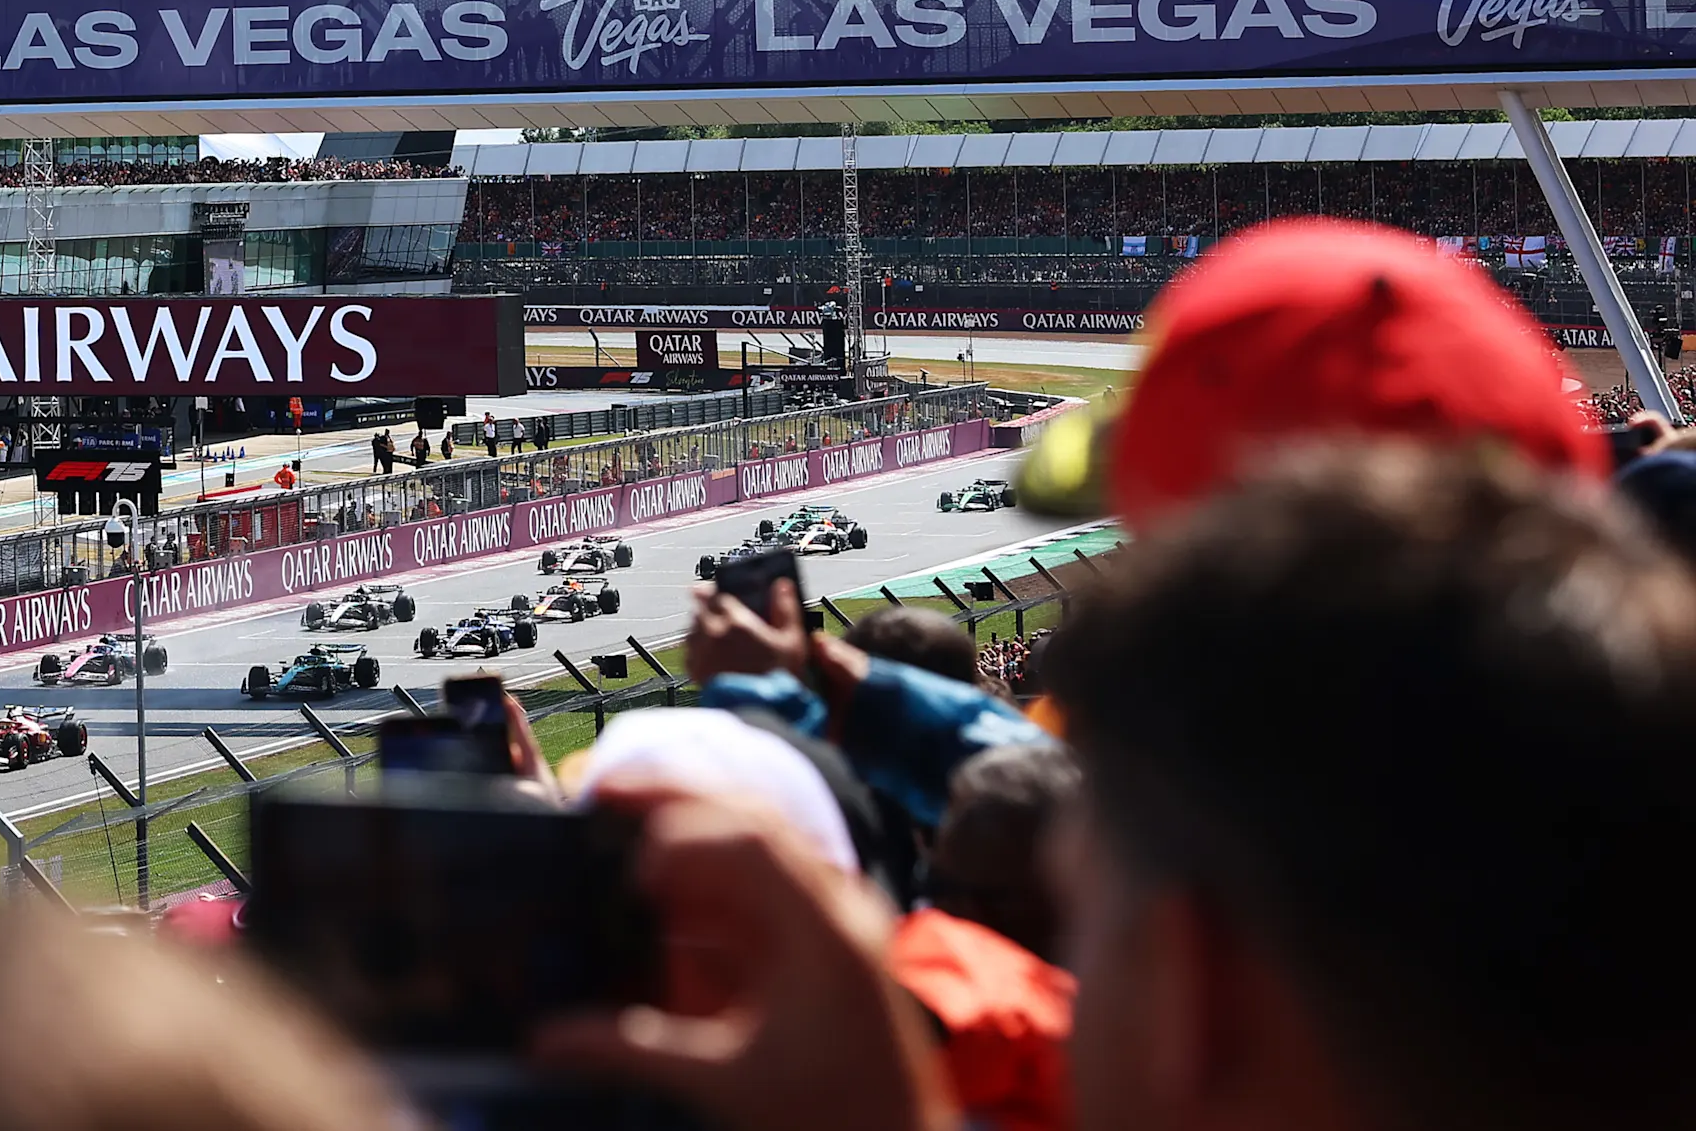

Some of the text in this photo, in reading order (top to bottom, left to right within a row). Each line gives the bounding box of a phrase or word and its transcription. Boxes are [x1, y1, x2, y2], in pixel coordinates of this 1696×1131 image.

[158, 0, 509, 67] VEGAS
[580, 309, 708, 324] QATAR AIRWAYS
[732, 310, 786, 326] QATAR
[873, 311, 999, 328] QATAR AIRWAYS
[1023, 313, 1145, 330] QATAR AIRWAYS
[649, 334, 702, 355] QATAR
[662, 353, 705, 365] AIRWAYS
[781, 374, 839, 382] QATAR AIRWAYS
[105, 462, 152, 481] 75
[630, 475, 706, 522] QATAR AIRWAYS
[529, 493, 615, 544] QATAR AIRWAYS
[413, 512, 511, 566] QATAR AIRWAYS
[281, 532, 393, 593] QATAR AIRWAYS
[185, 558, 253, 610] AIRWAYS
[12, 587, 92, 645] AIRWAYS
